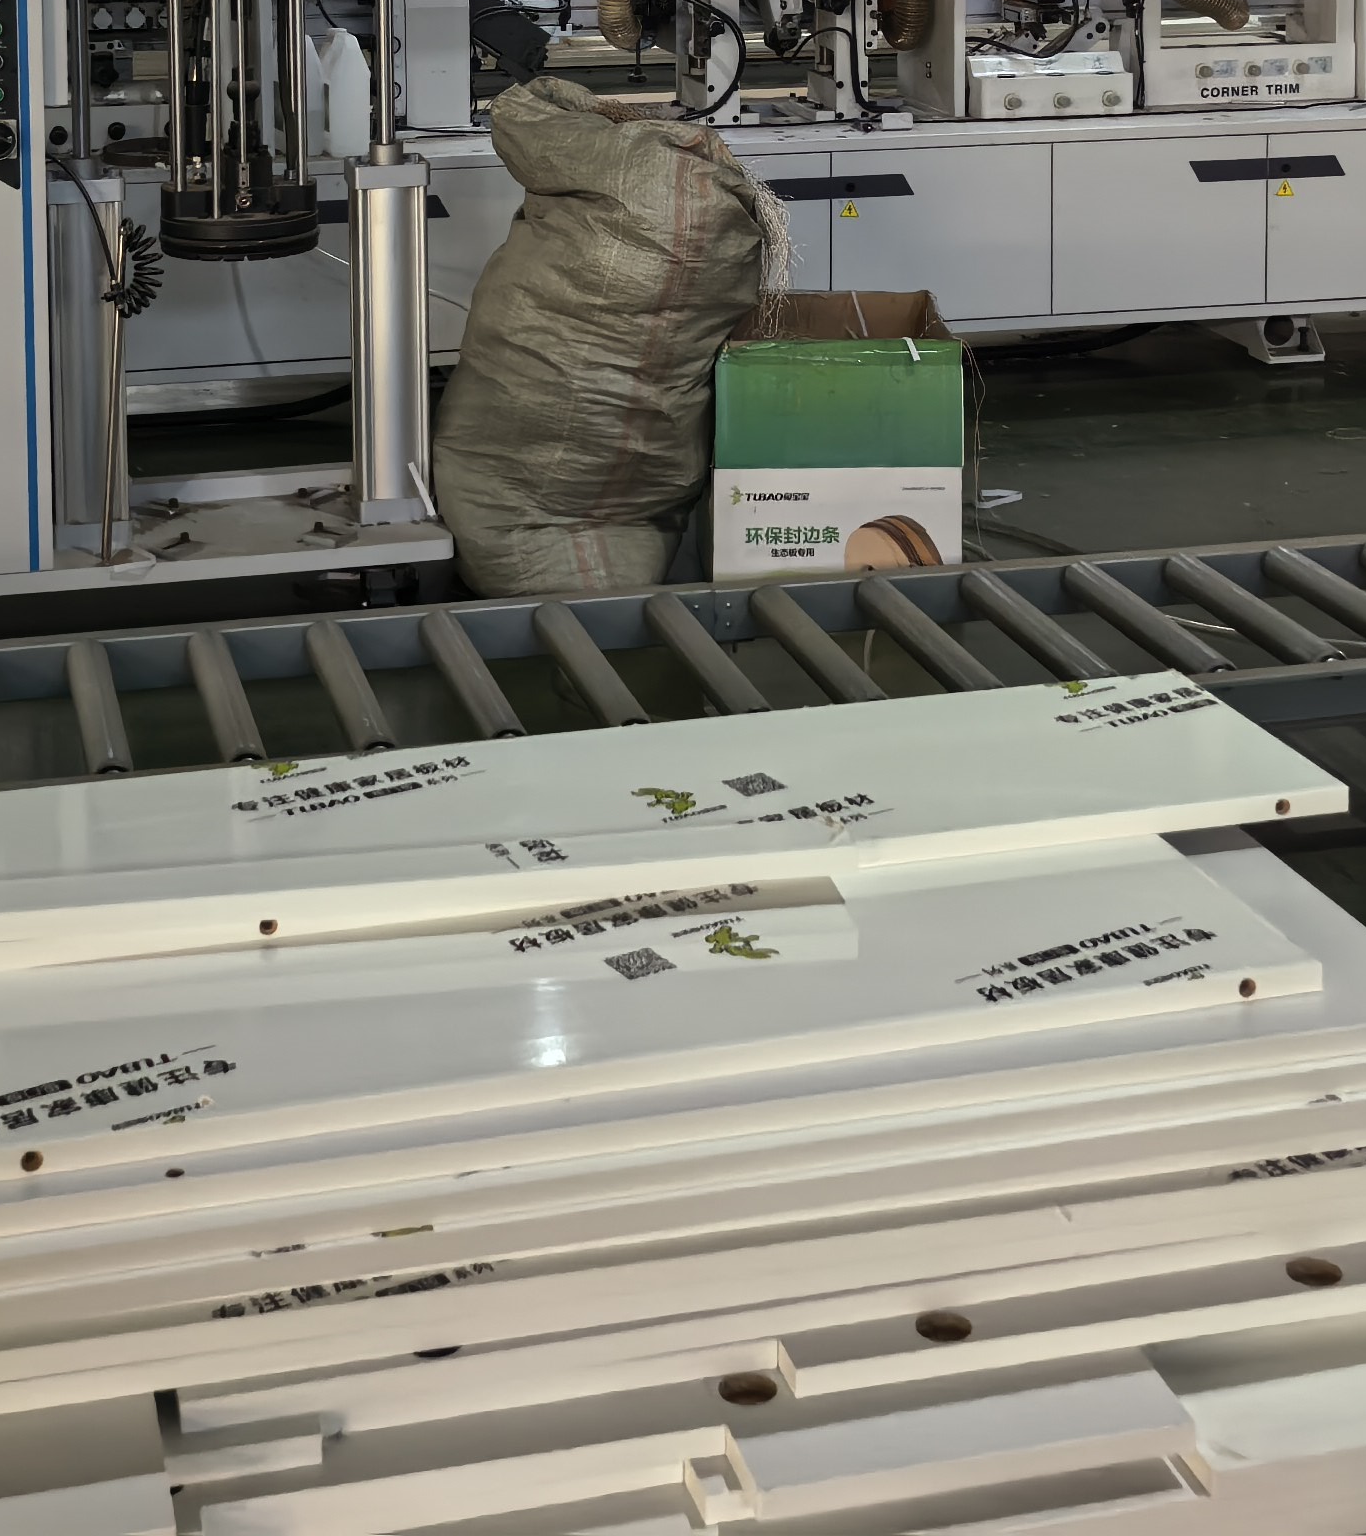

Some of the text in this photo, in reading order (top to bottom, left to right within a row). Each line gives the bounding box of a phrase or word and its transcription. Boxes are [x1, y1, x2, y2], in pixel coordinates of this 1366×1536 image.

[1200, 83, 1301, 99] CORNER TRIM
[745, 526, 840, 545] 环保封边条
